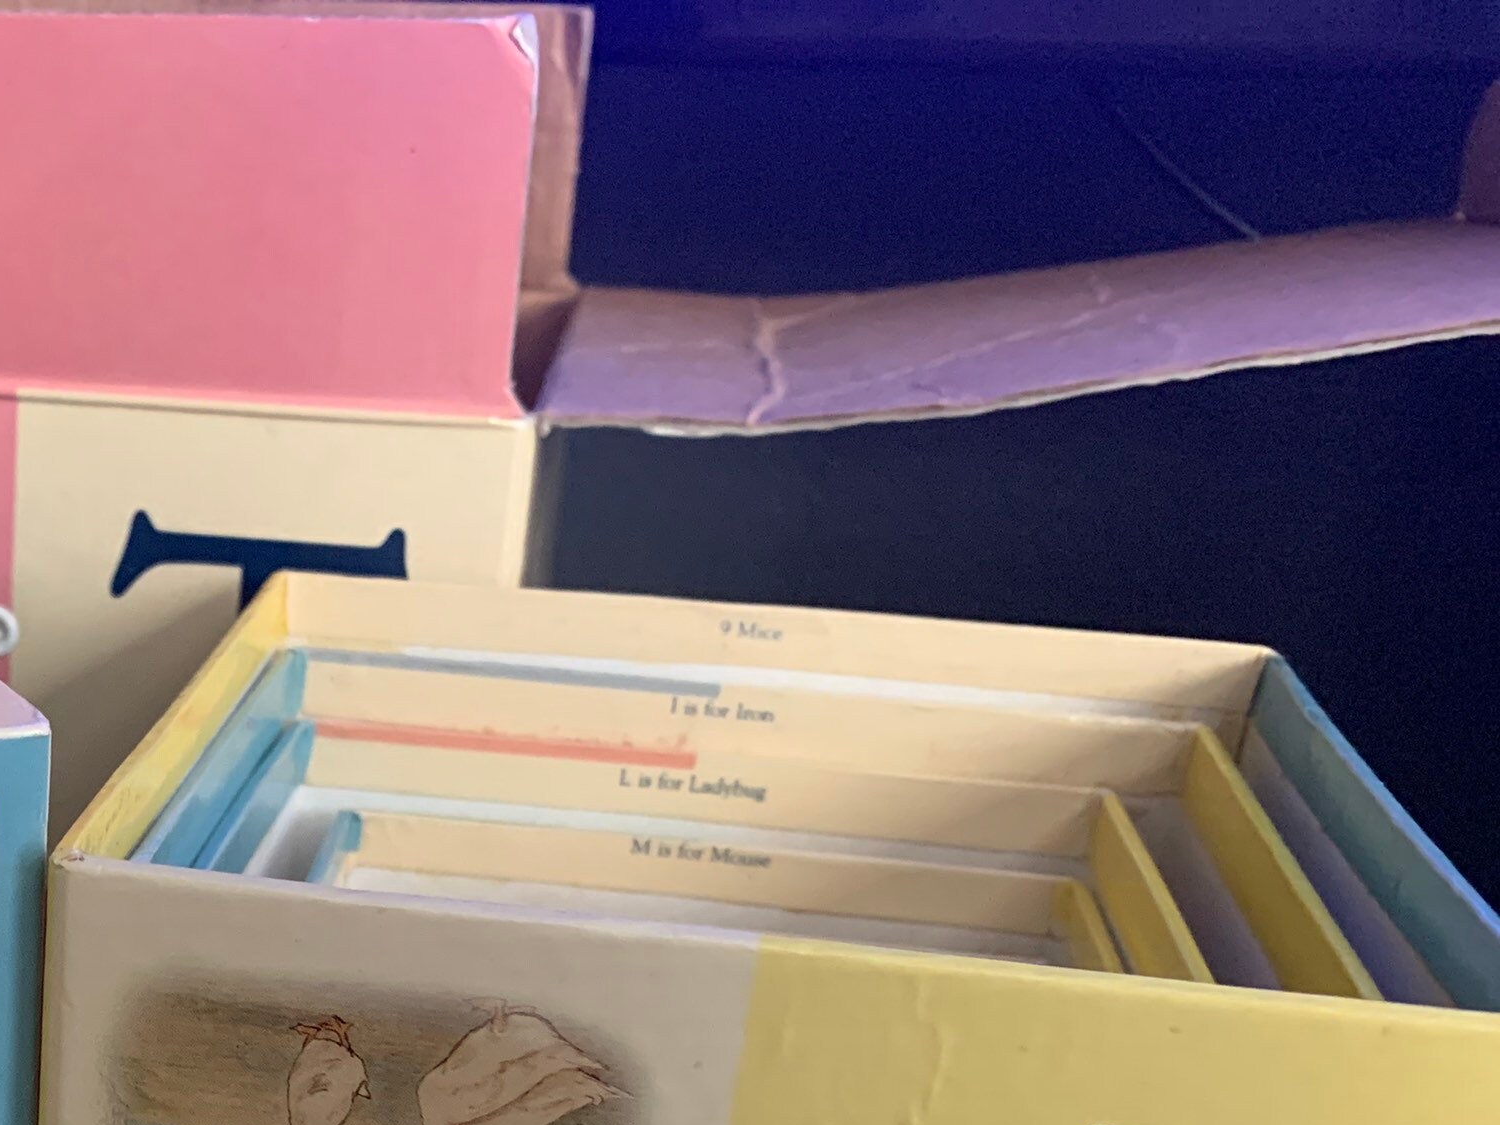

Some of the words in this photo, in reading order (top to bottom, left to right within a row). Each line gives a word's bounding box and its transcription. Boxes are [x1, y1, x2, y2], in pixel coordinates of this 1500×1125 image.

[670, 696, 677, 714] I
[684, 703, 697, 716] is
[704, 700, 729, 718] for
[736, 702, 775, 722] Iron
[619, 768, 631, 787] L
[639, 774, 652, 789] is
[658, 773, 683, 791] for
[689, 775, 767, 803] Ladybug
[630, 839, 651, 856] M
[658, 842, 672, 858] is
[676, 842, 704, 860] for
[710, 847, 772, 868] Mouse
